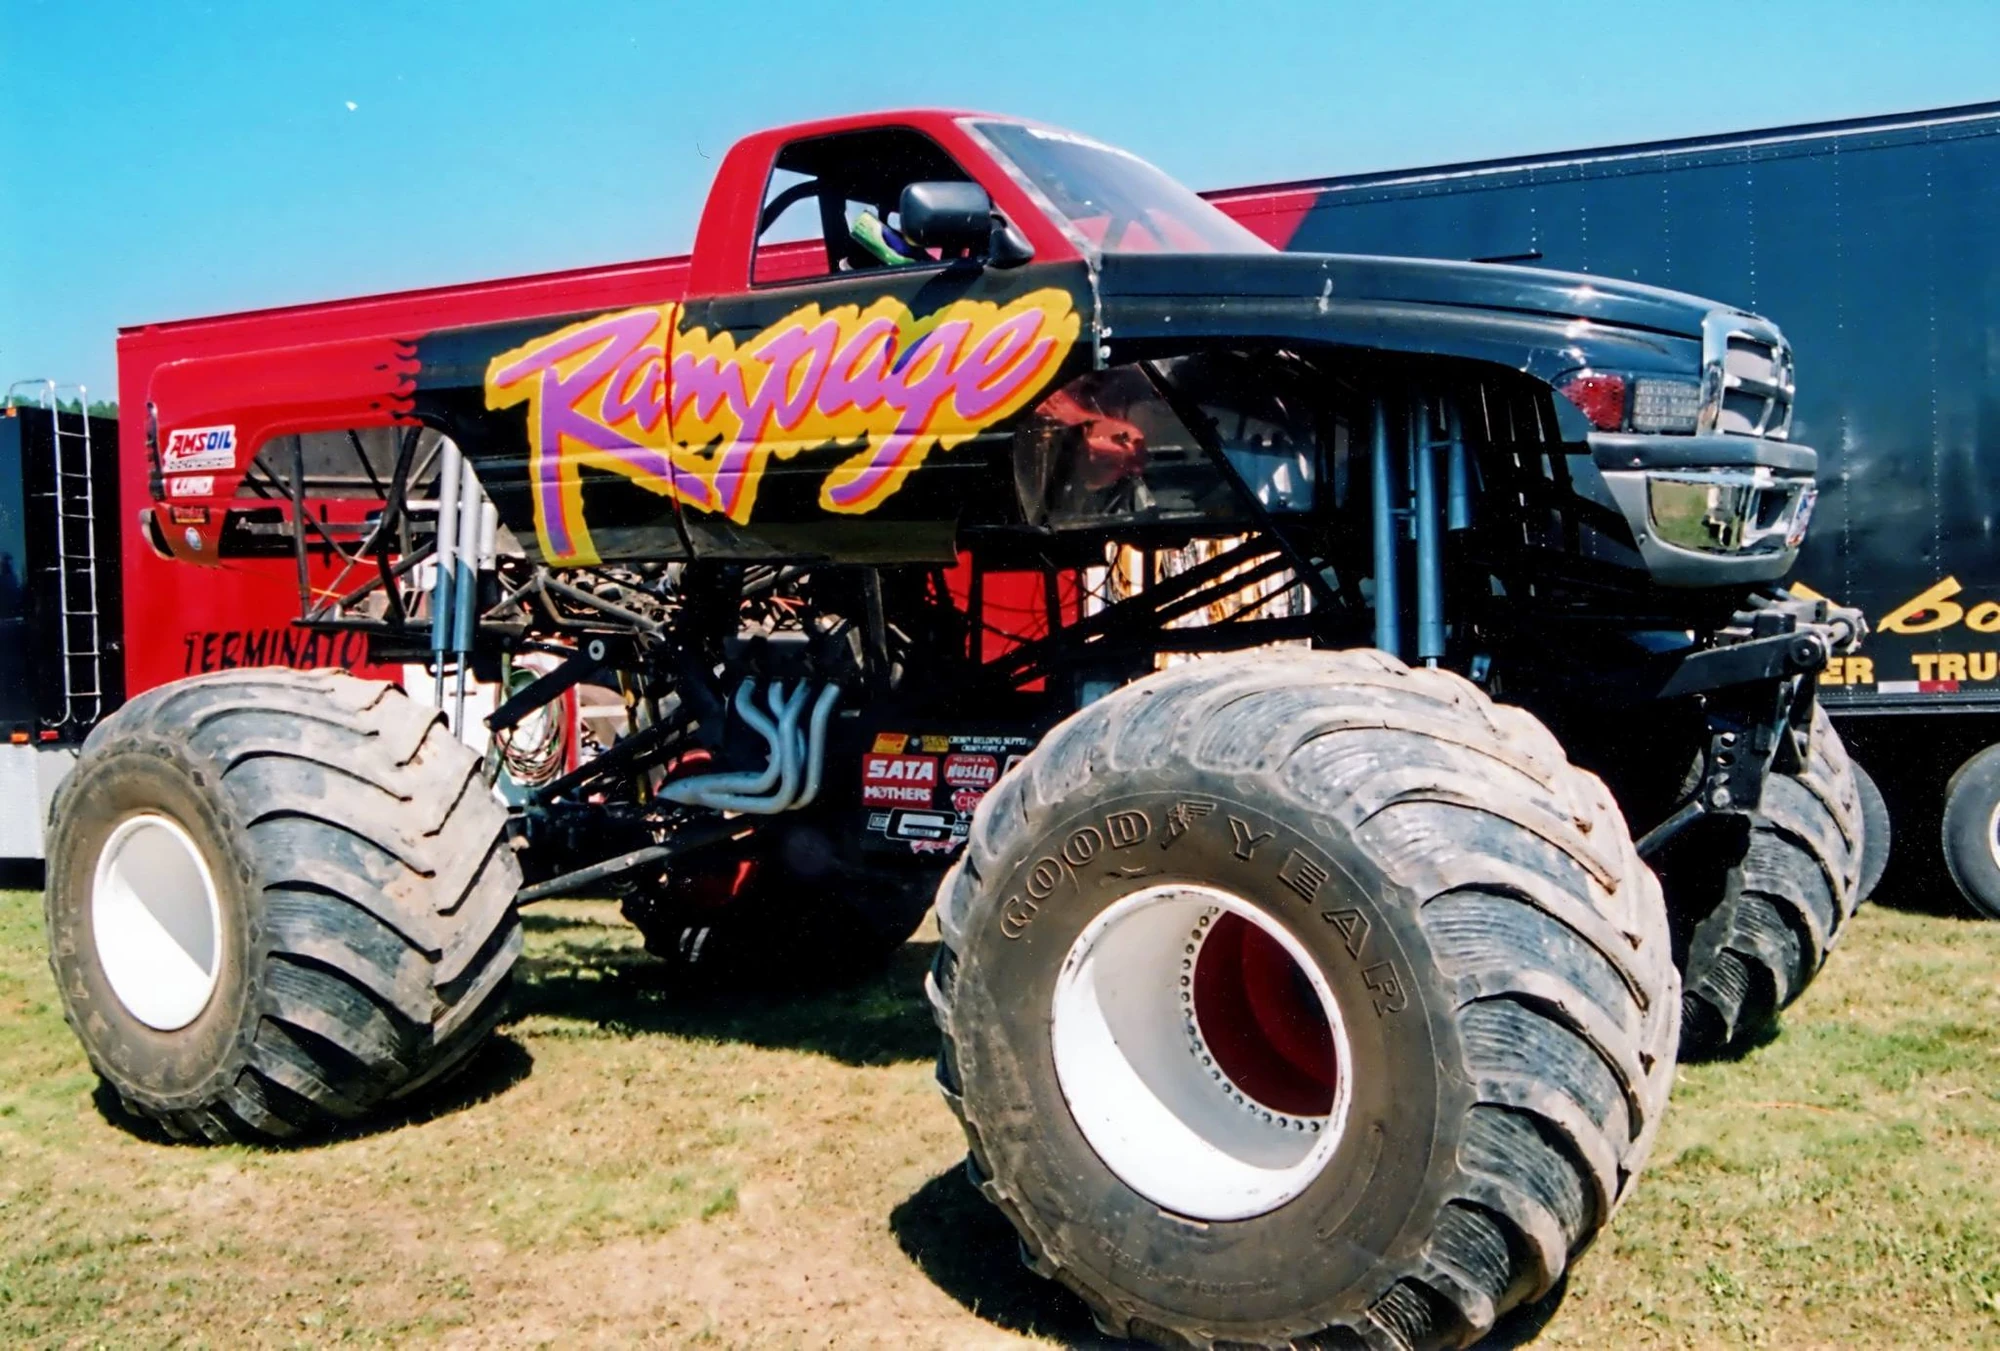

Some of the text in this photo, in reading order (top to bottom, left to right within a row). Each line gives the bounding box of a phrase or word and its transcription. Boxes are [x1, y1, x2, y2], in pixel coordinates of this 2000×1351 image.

[484, 288, 1080, 567] Rampage
[169, 430, 232, 458] AMSOIL
[184, 628, 370, 674] TERMINATO
[1819, 652, 2000, 685] ER TRU
[867, 759, 933, 780] SATA
[864, 786, 931, 801] MOTHERS
